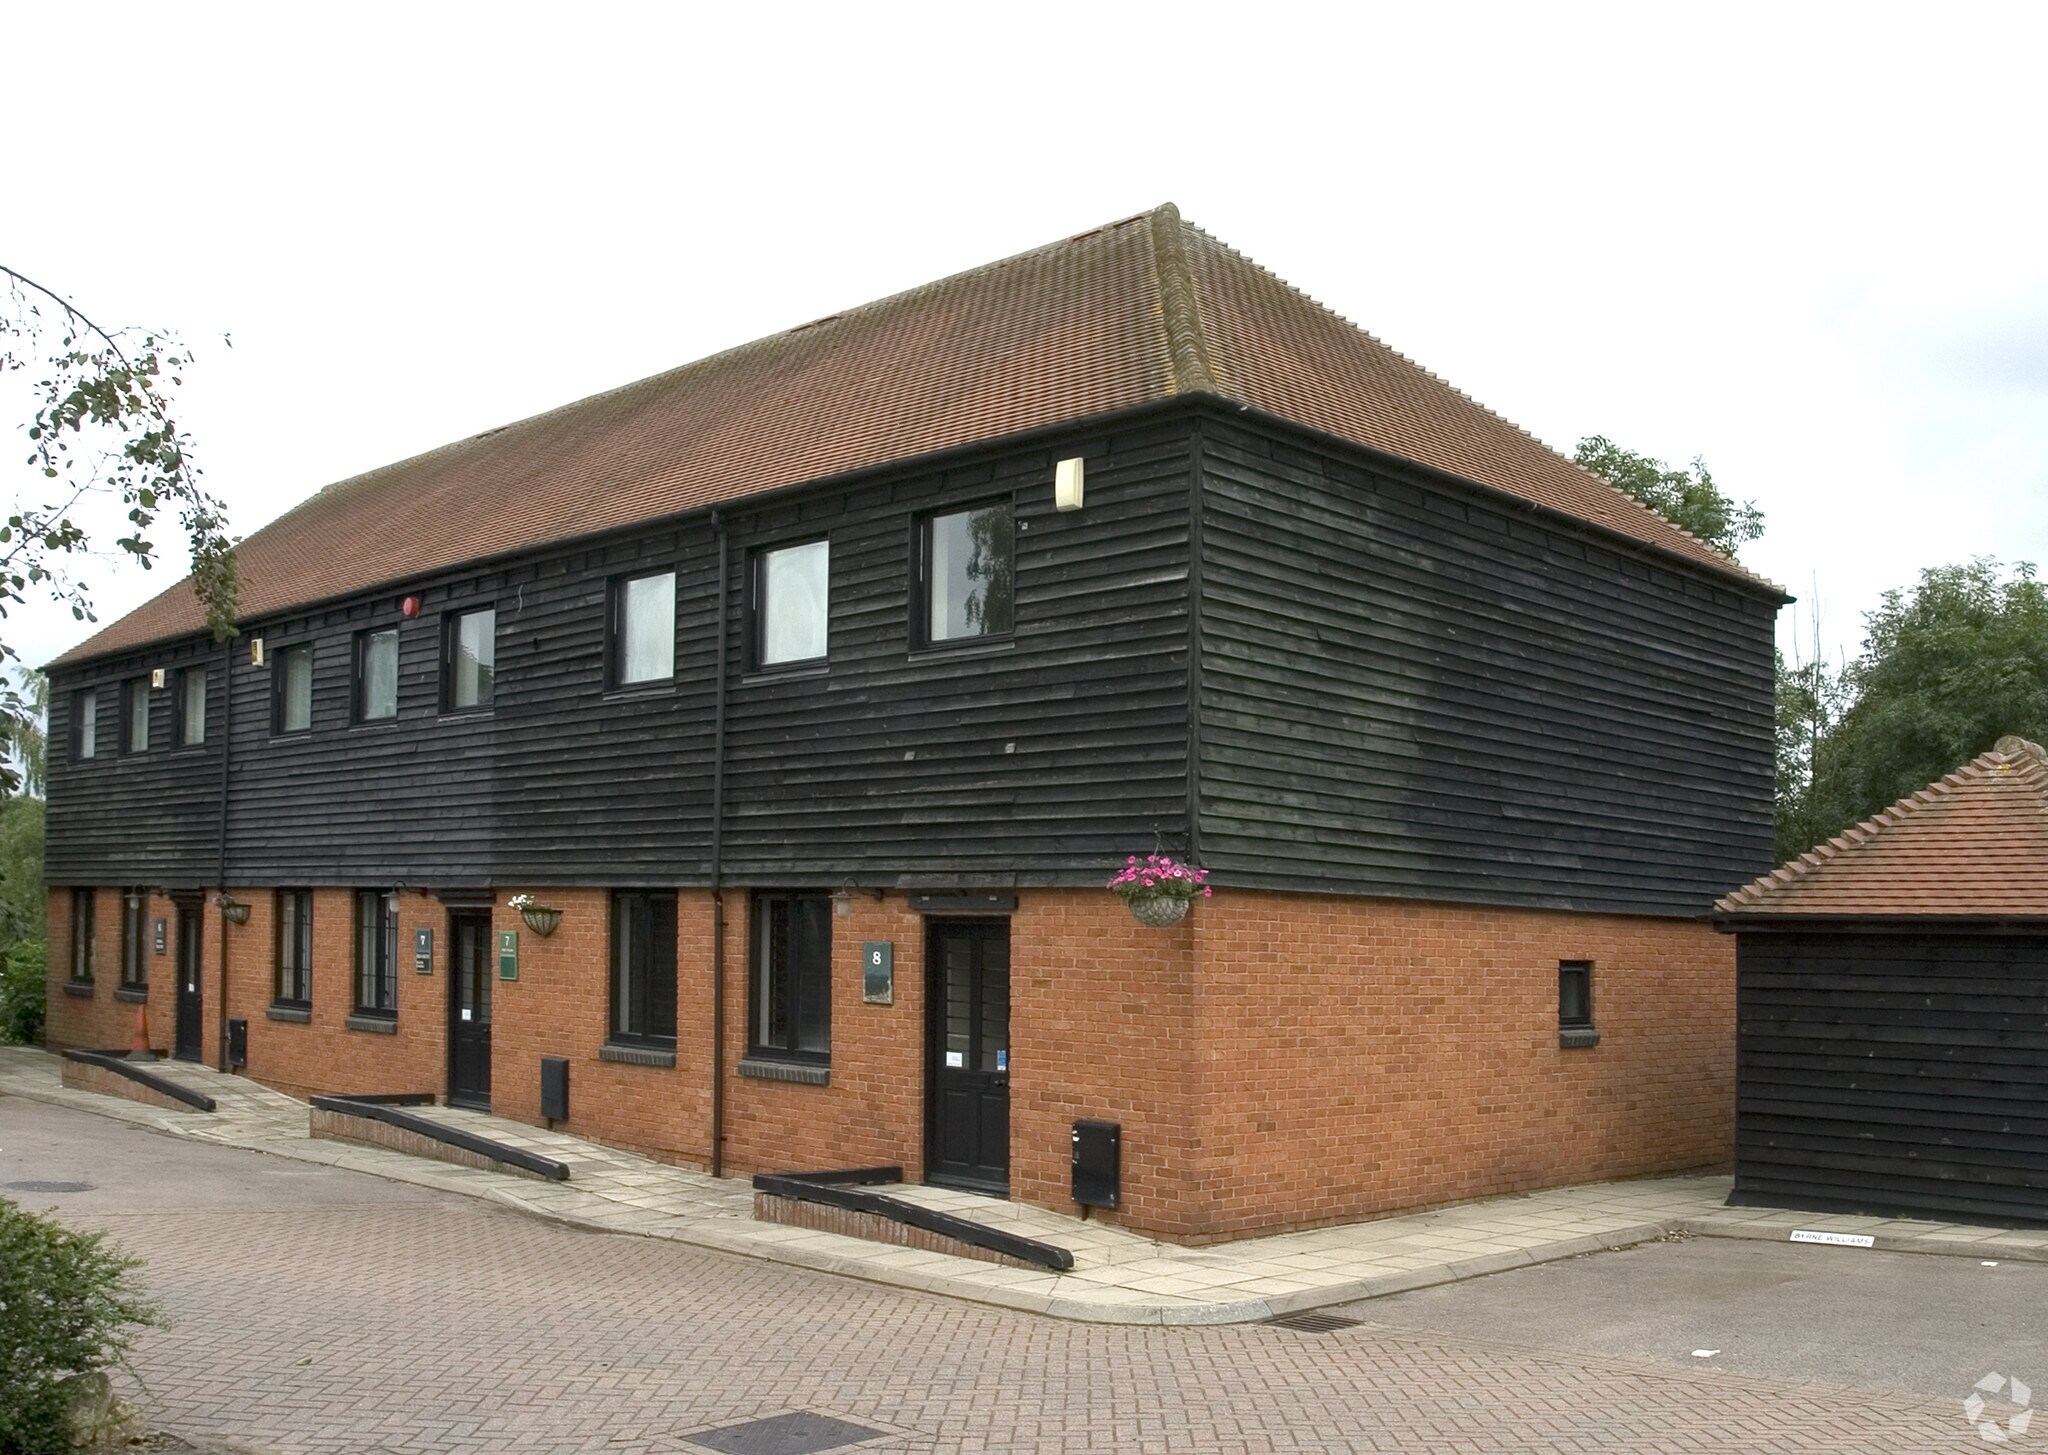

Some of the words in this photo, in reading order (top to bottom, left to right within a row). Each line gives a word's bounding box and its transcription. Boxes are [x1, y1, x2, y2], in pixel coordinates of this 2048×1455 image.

[420, 935, 426, 945] 7
[505, 936, 510, 946] 7
[872, 951, 881, 965] 8
[1794, 1233, 1823, 1241] BYRNE
[1826, 1235, 1869, 1244] WILLIAMS
